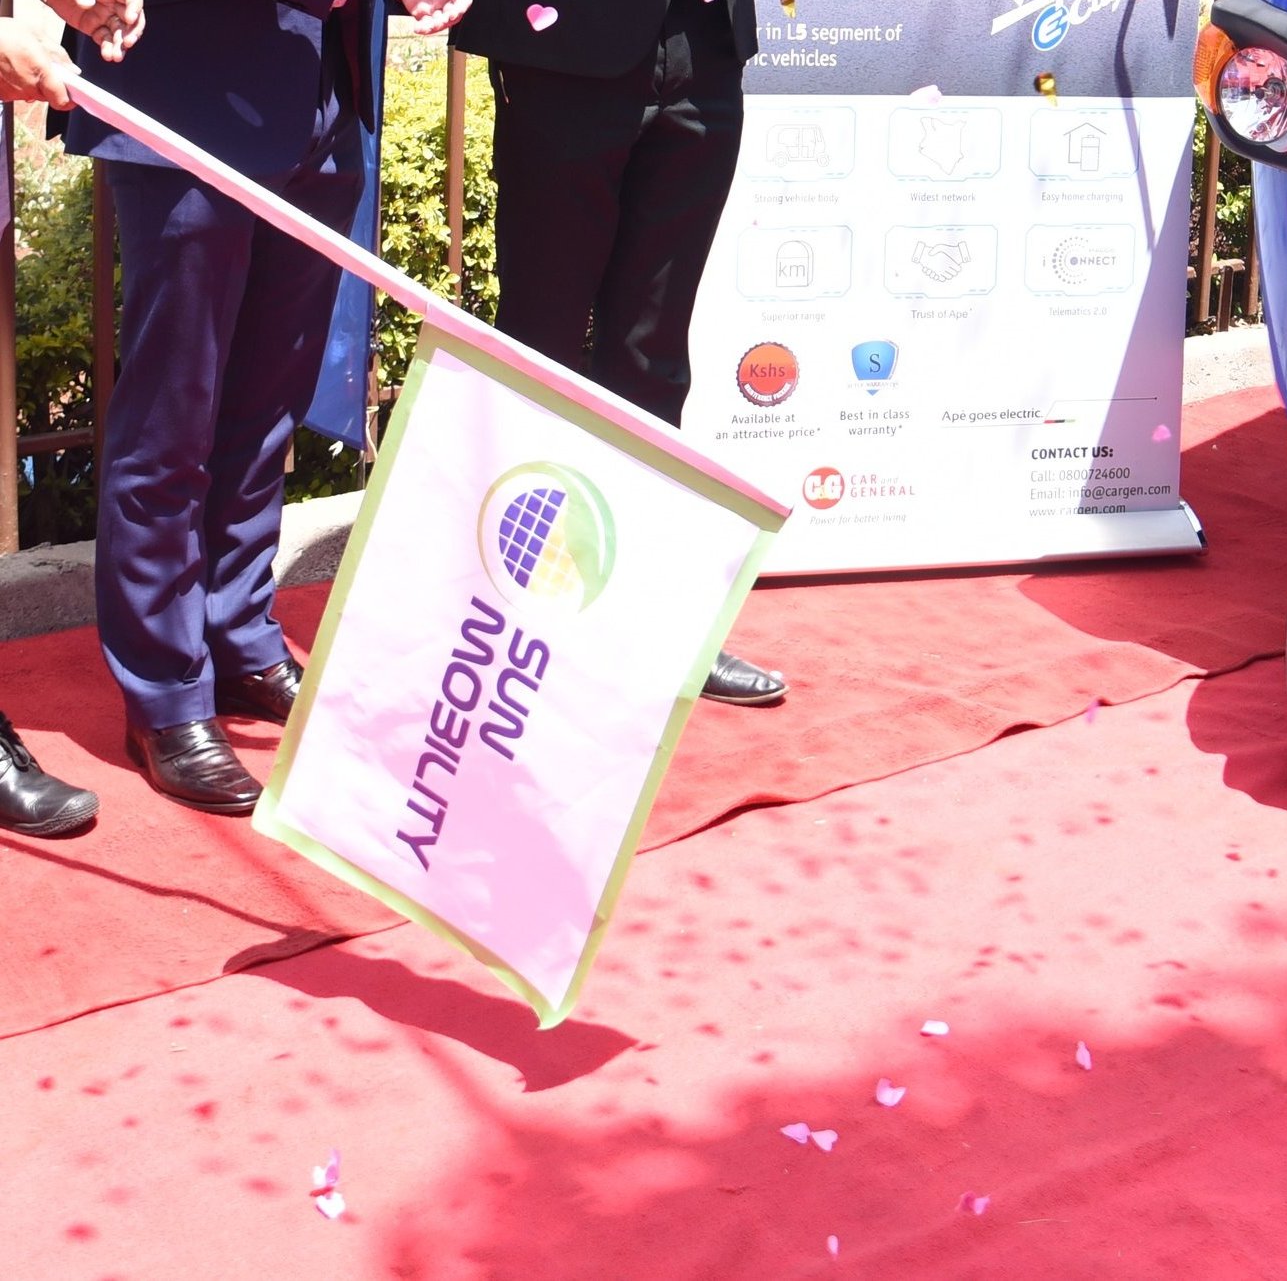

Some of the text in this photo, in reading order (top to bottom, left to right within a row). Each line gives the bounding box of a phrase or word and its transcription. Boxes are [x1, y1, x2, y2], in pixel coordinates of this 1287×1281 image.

[766, 22, 781, 40] in
[787, 23, 807, 40] L5
[812, 24, 881, 45] segment
[885, 23, 903, 41] of
[772, 49, 837, 67] vehicles
[754, 192, 840, 205] Strong vehicle body
[910, 192, 976, 203] Widest network
[1041, 191, 1124, 204] Easy home charging
[778, 261, 806, 278] km
[760, 311, 826, 324] Superior range
[910, 309, 935, 319] Trust
[937, 309, 947, 319] of
[1049, 306, 1107, 317] Telematics 2.0
[868, 352, 882, 374] S
[750, 362, 786, 379] Kshs
[731, 413, 796, 425] Available at
[839, 409, 910, 421] Best in class
[968, 412, 998, 423] goes
[715, 431, 729, 440] an
[732, 427, 785, 439] attractive
[1031, 446, 1114, 460] CONTACT US:
[850, 474, 877, 486] CAR
[1030, 467, 1131, 482] Call: 0800724600
[850, 485, 917, 498] GENERAL
[1030, 483, 1171, 500] Email: info@cargen.com
[809, 512, 907, 526] Power for better living
[479, 627, 550, 761] SUN
[396, 595, 506, 872] MOBILITY
